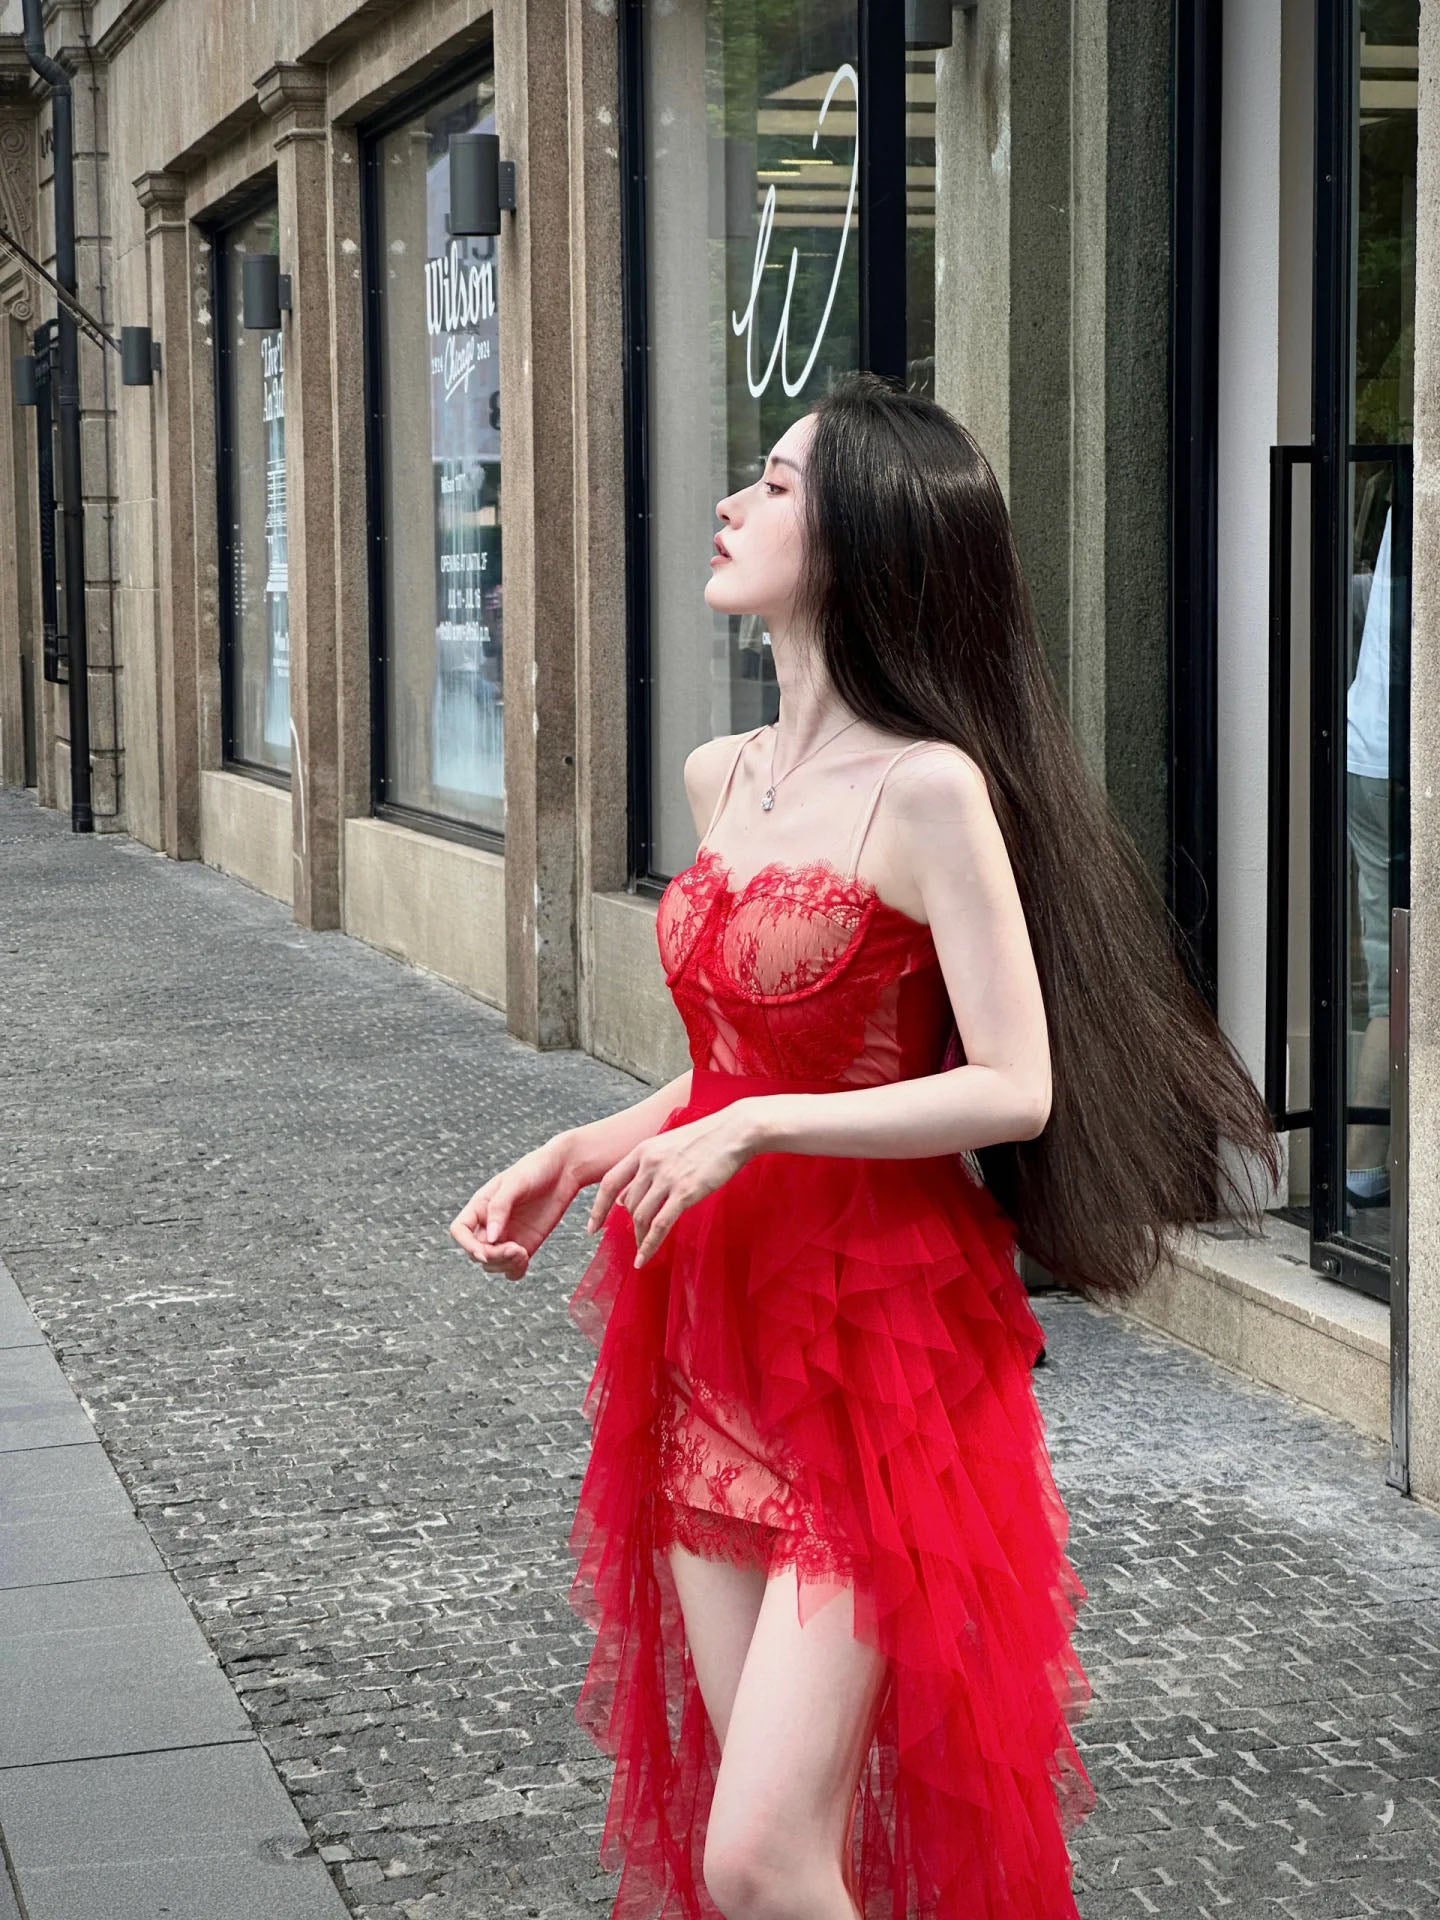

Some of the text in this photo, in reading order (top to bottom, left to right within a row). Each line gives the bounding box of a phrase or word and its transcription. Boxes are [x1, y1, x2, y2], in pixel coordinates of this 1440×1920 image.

[424, 240, 496, 335] Wilson
[444, 334, 475, 400] Chicago
[476, 339, 491, 361] 2024
